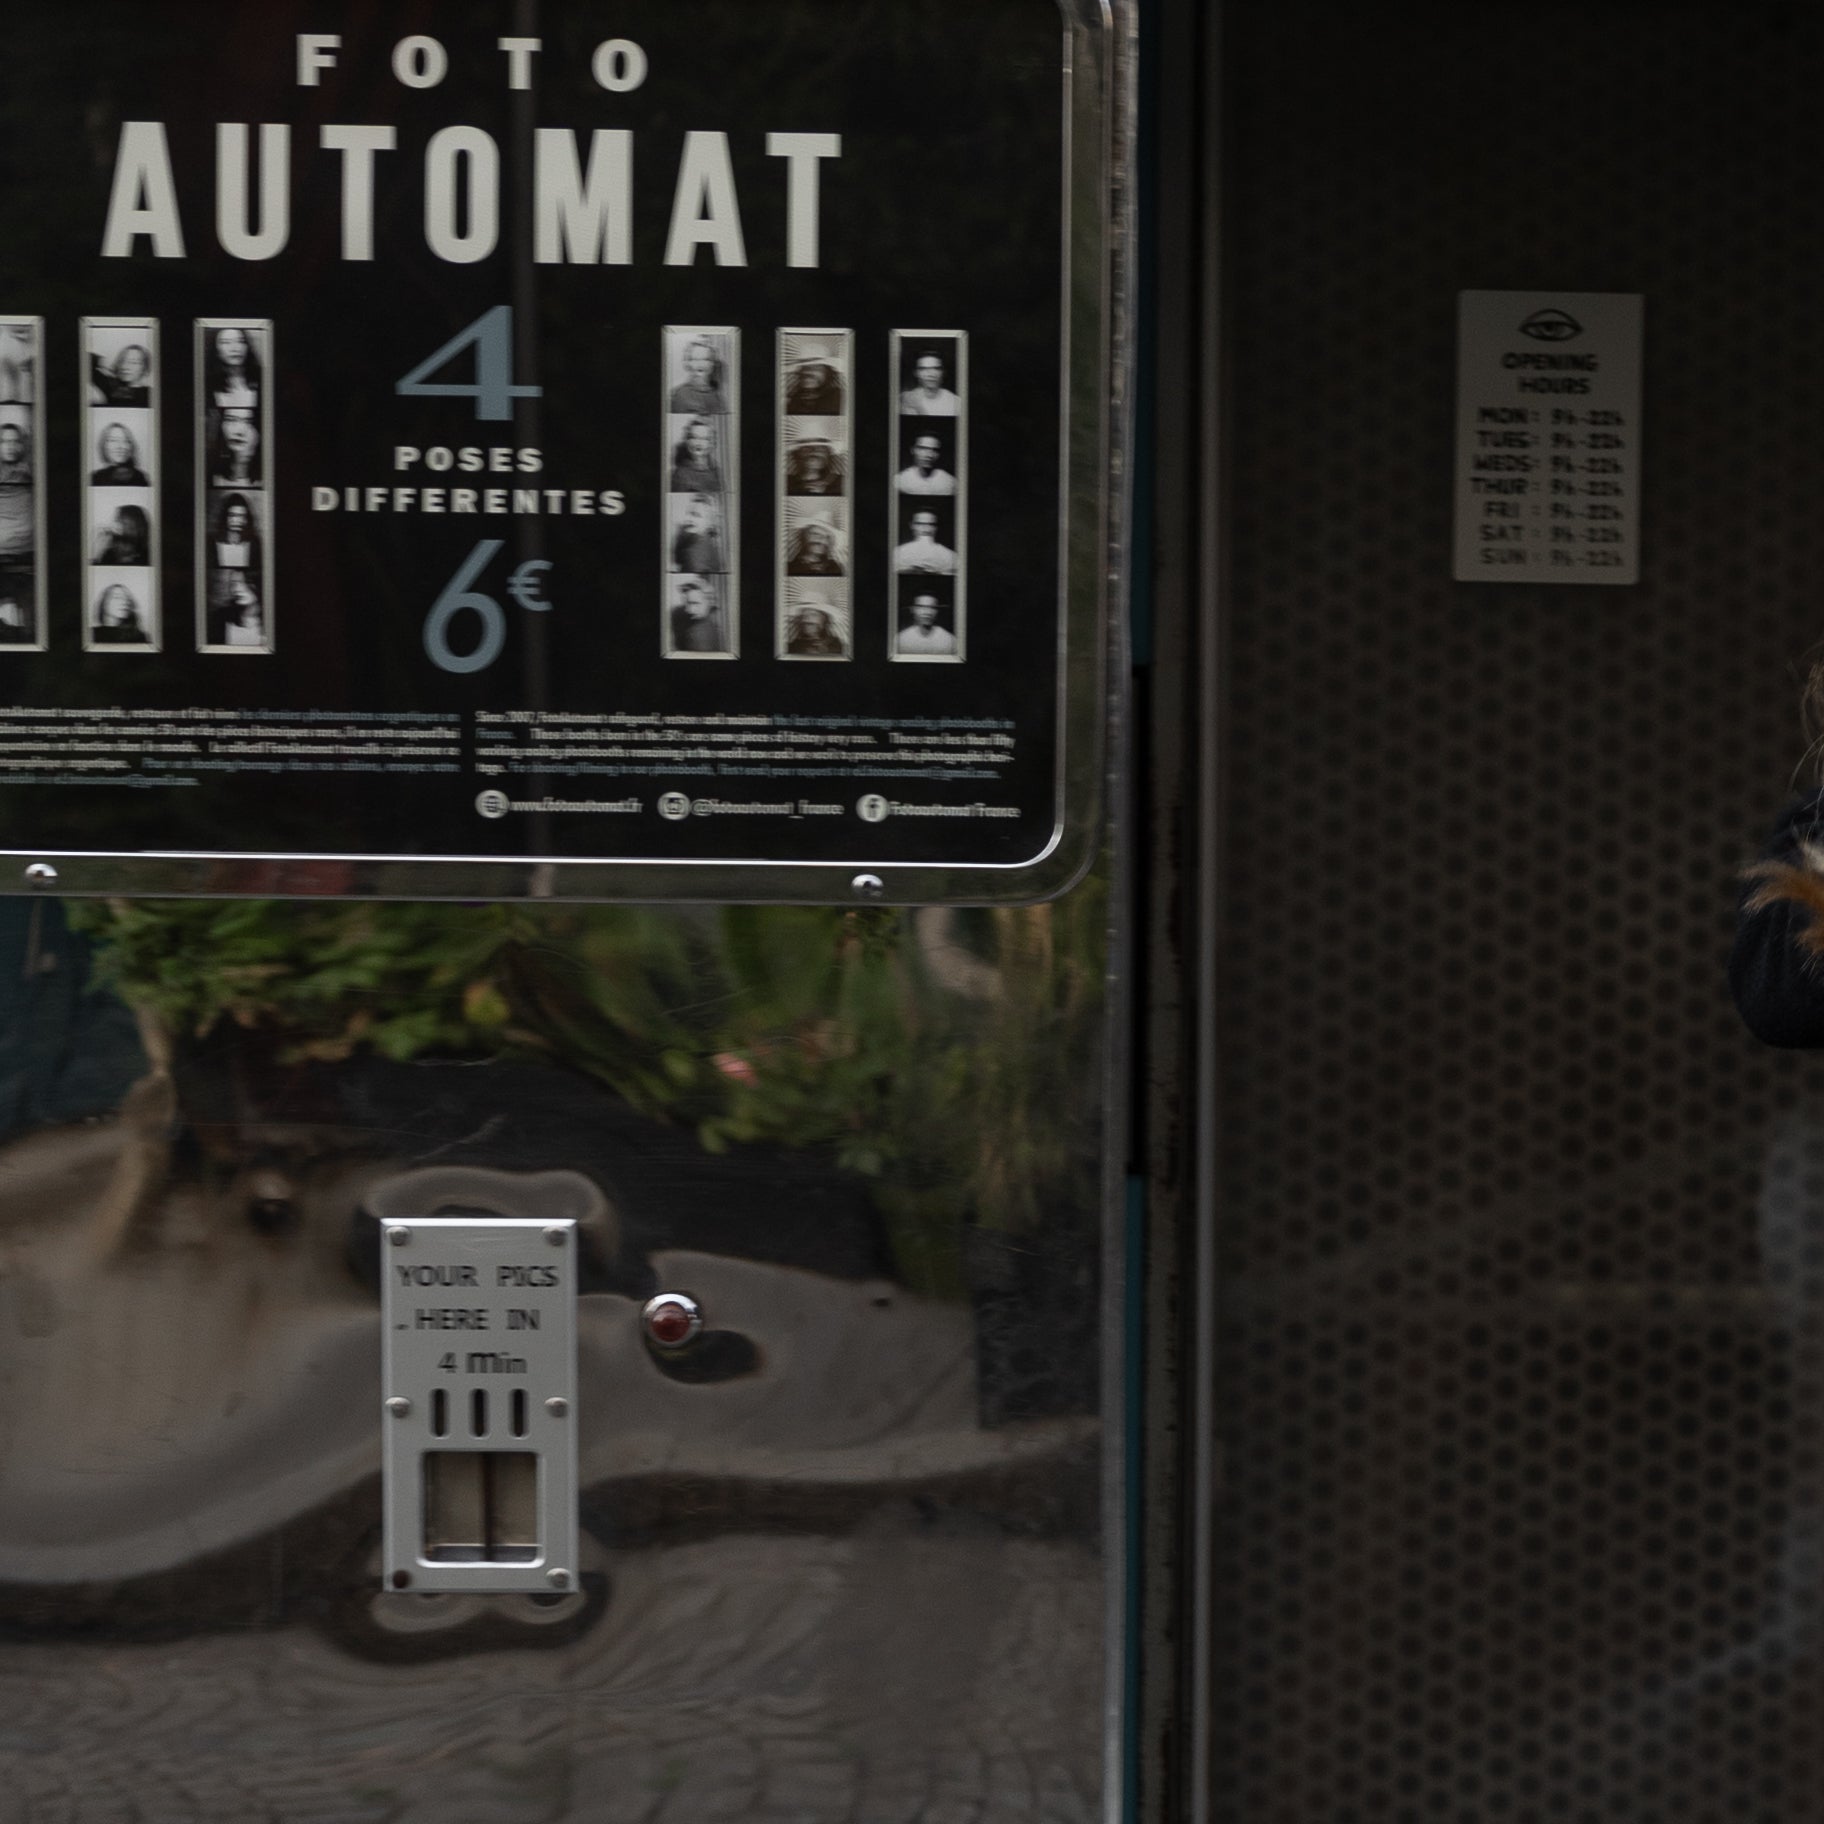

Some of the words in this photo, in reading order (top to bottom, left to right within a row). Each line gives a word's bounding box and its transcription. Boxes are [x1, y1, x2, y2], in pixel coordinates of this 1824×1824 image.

[297, 33, 648, 93] FOTO
[101, 121, 841, 269] AUTOMAT
[396, 305, 543, 421] 4
[1503, 352, 1598, 372] OPENING
[1518, 377, 1591, 395] HOURS
[395, 446, 543, 473] POSES
[312, 486, 626, 516] DIFFERENTES
[397, 1265, 479, 1287] YOUR
[497, 1265, 559, 1288] PICS
[415, 1308, 489, 1331] HERE
[505, 1308, 541, 1331] IN
[437, 1352, 457, 1374] 4
